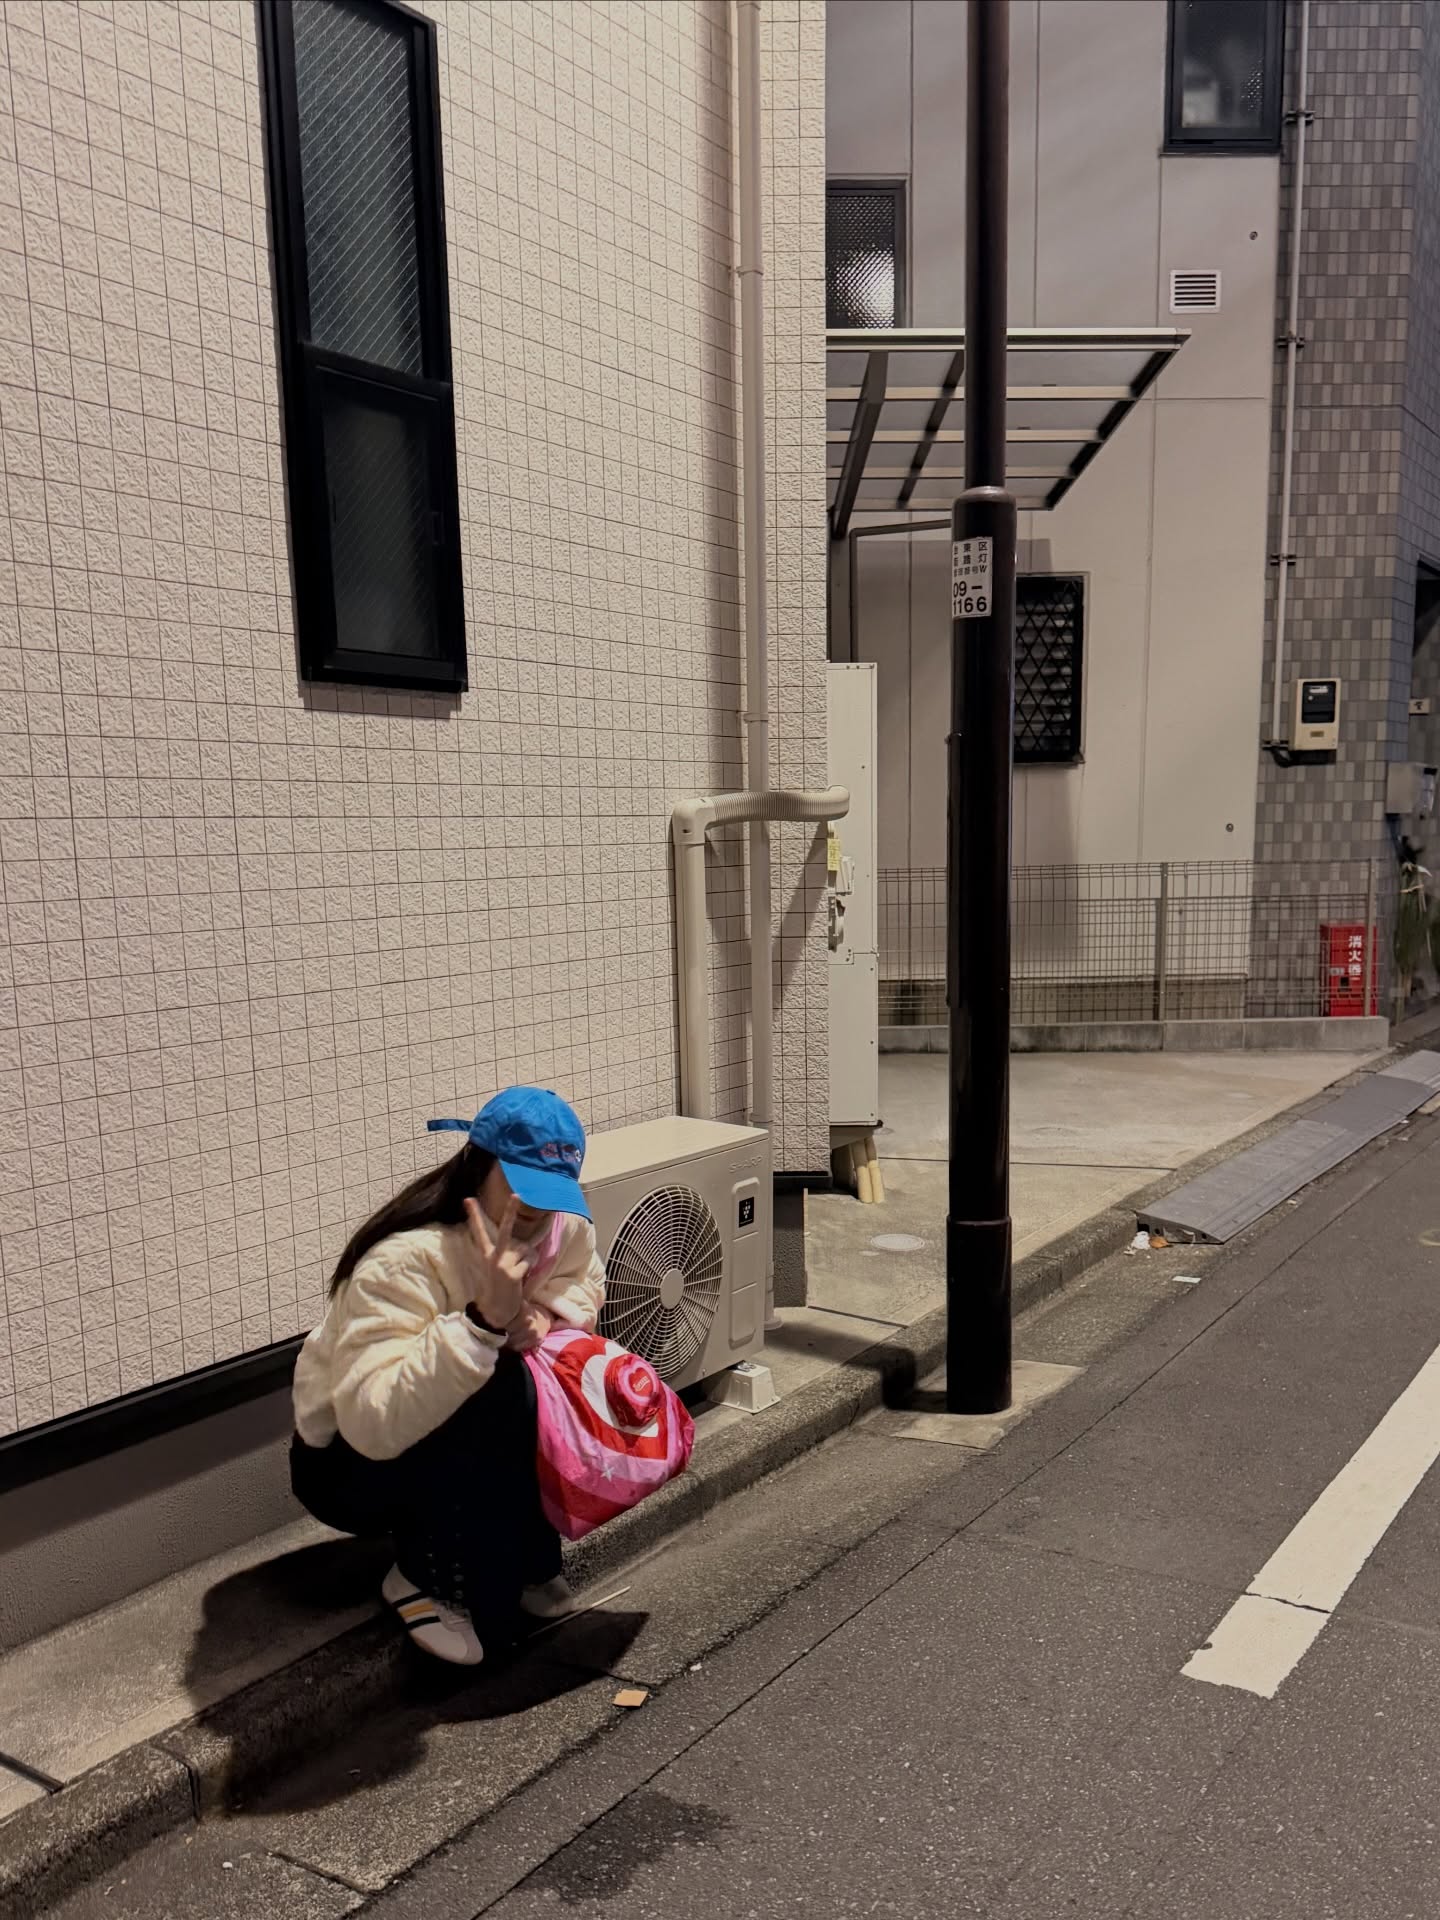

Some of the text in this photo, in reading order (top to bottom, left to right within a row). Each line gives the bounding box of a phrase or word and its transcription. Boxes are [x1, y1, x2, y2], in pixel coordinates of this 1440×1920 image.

[953, 596, 987, 615] 1166
[1348, 935, 1362, 976] 消火器
